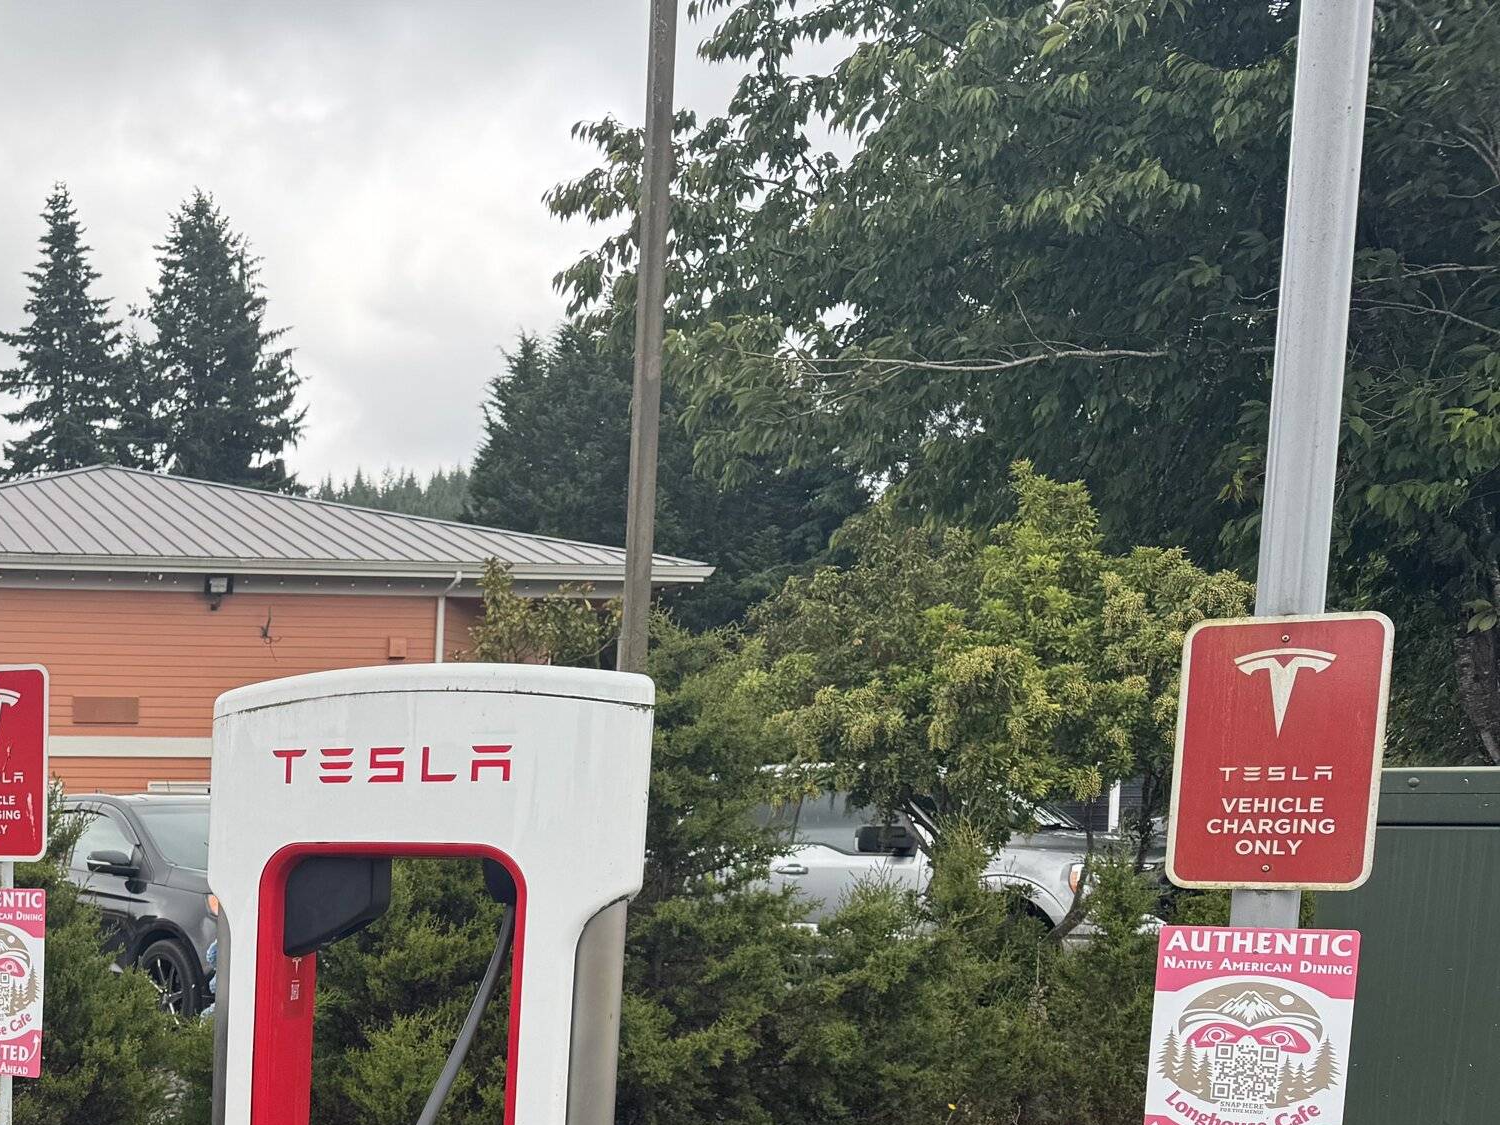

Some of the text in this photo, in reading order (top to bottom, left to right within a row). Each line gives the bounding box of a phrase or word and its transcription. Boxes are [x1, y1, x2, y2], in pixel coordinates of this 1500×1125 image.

[272, 744, 513, 785] TESLA
[1218, 765, 1334, 782] TESLA
[1221, 797, 1325, 814] VEHICLE
[1206, 818, 1336, 835] CHARGING
[1235, 839, 1303, 856] ONLY
[1165, 929, 1353, 957] AUTHENTIC
[1163, 955, 1353, 976] NATIVE AMERICAN DINING
[9, 1012, 33, 1033] Cafe
[1220, 1101, 1265, 1110] SNAP HERE
